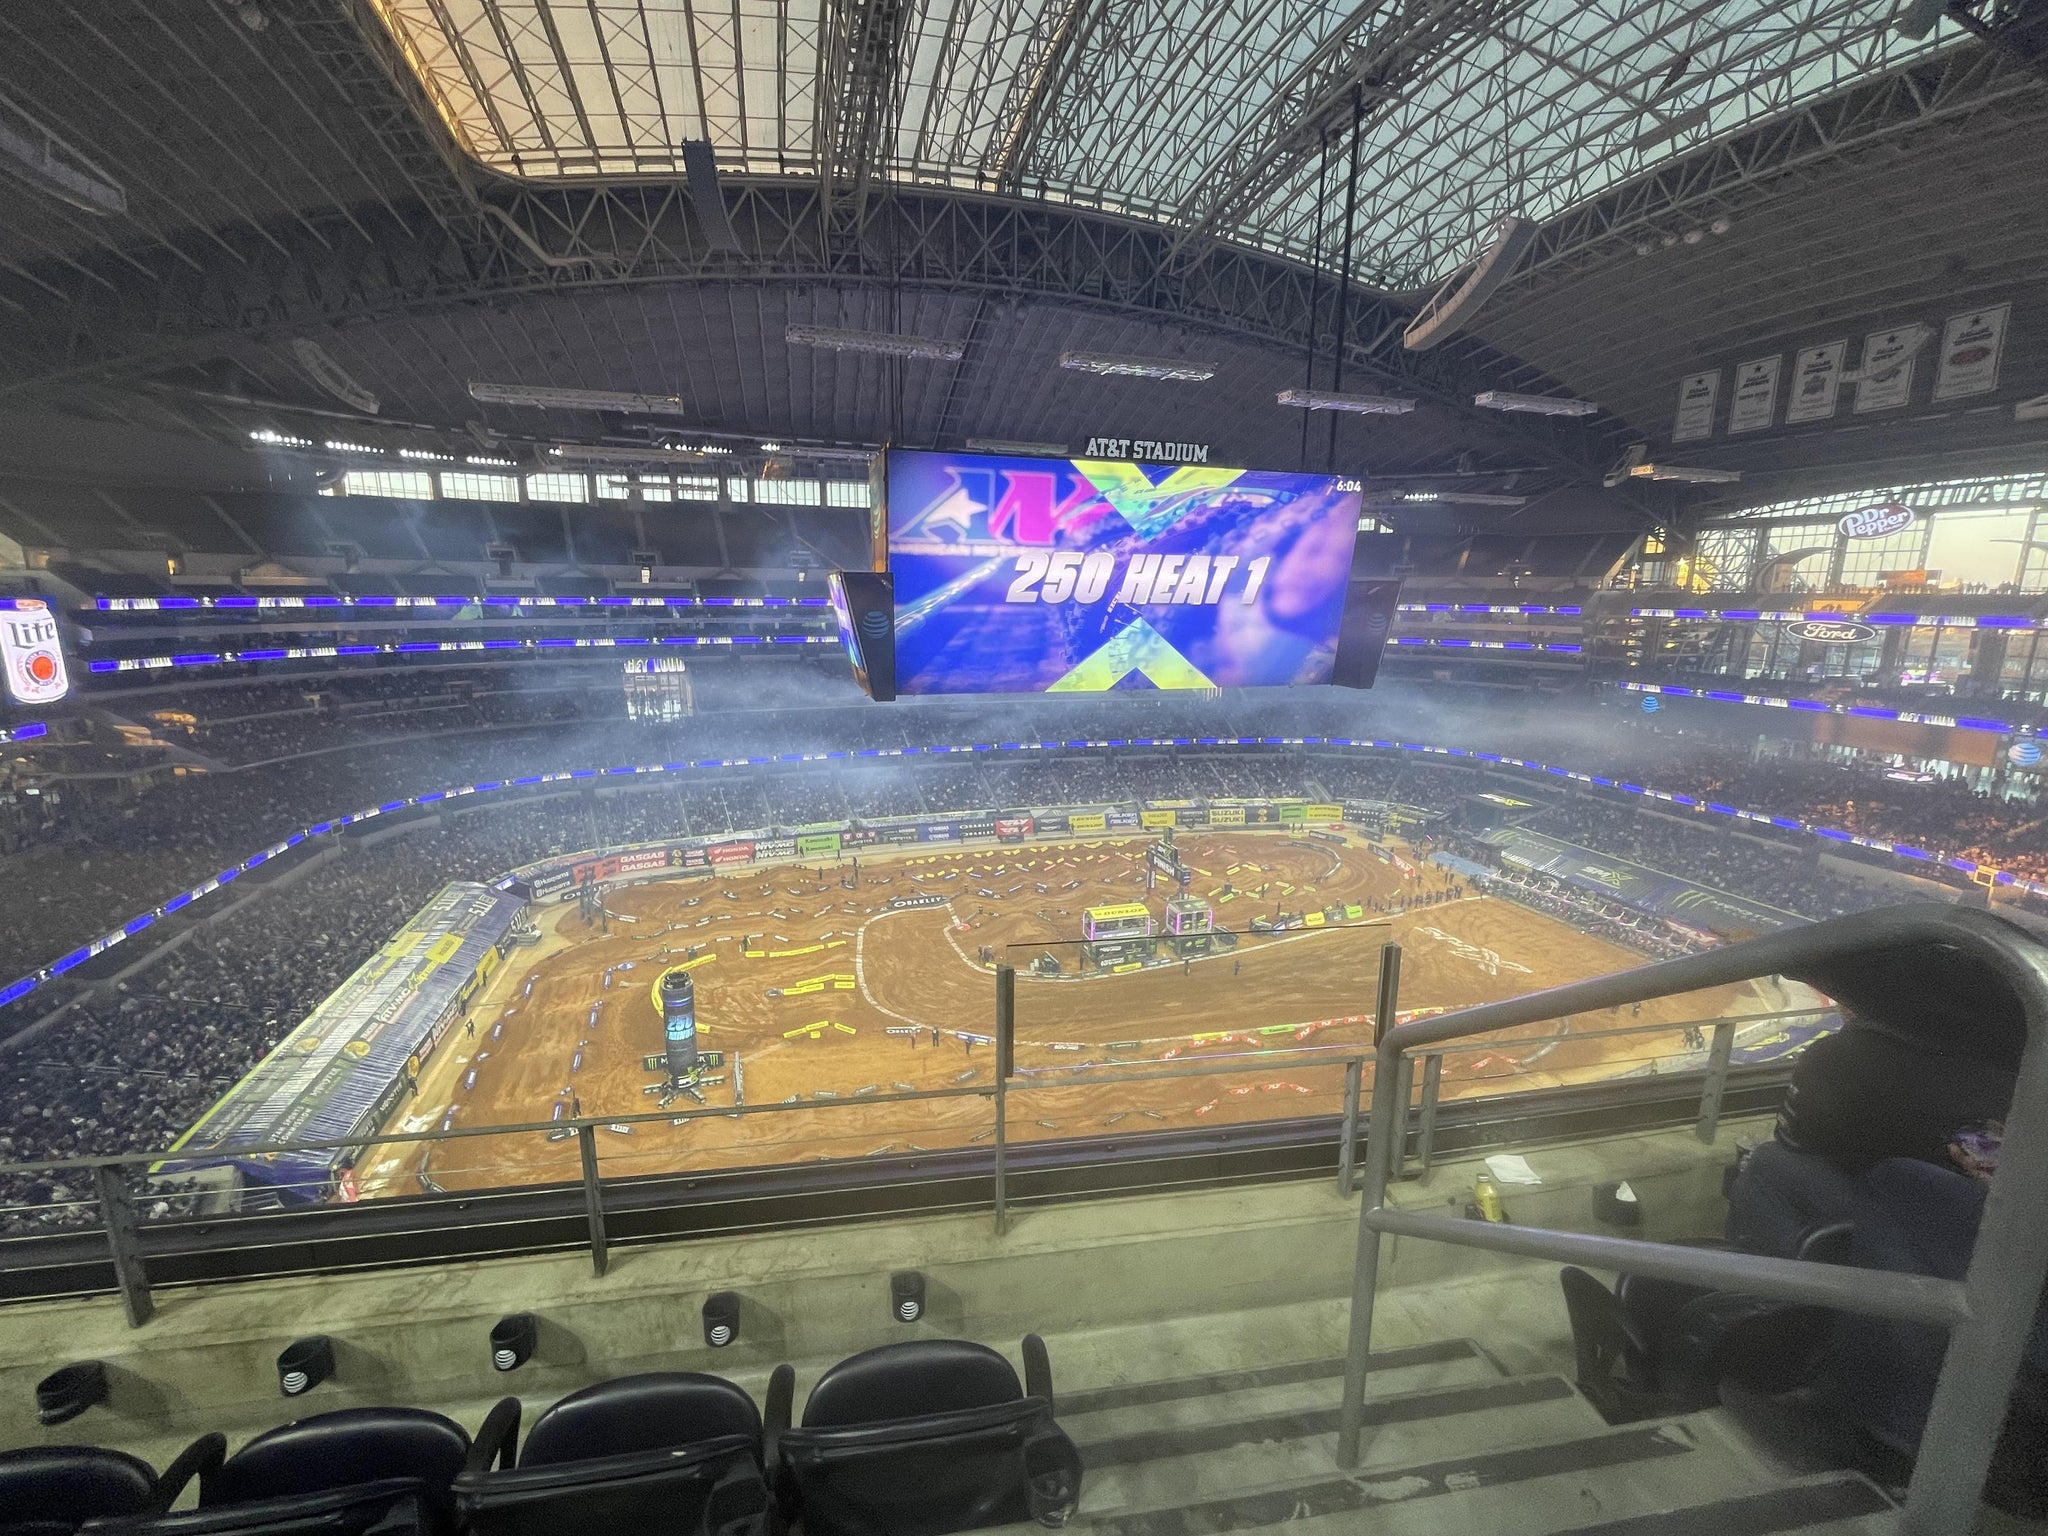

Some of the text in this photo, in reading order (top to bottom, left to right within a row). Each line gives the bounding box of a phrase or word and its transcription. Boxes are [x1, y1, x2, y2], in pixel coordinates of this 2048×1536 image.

[1085, 437, 1209, 463] AT&T STADIUM
[1336, 480, 1361, 492] 6:04
[1846, 511, 1908, 537] Pepper
[1861, 507, 1890, 525] Dr
[1005, 552, 1271, 605] 250 HEAT 1
[7, 621, 55, 649] Lite
[1803, 623, 1857, 640] Ford
[1211, 816, 1244, 824] SUZUKI
[620, 851, 665, 863] GASGAS
[722, 845, 749, 854] HONDA
[621, 860, 666, 872] GASGAS
[722, 854, 750, 863] HONDA
[1153, 856, 1175, 877] FINISH
[1104, 907, 1145, 916] DUNLOP
[667, 1014, 693, 1031] 250
[268, 1106, 304, 1142] UTAH SPORTS
[278, 1108, 312, 1144] COMMISSION
